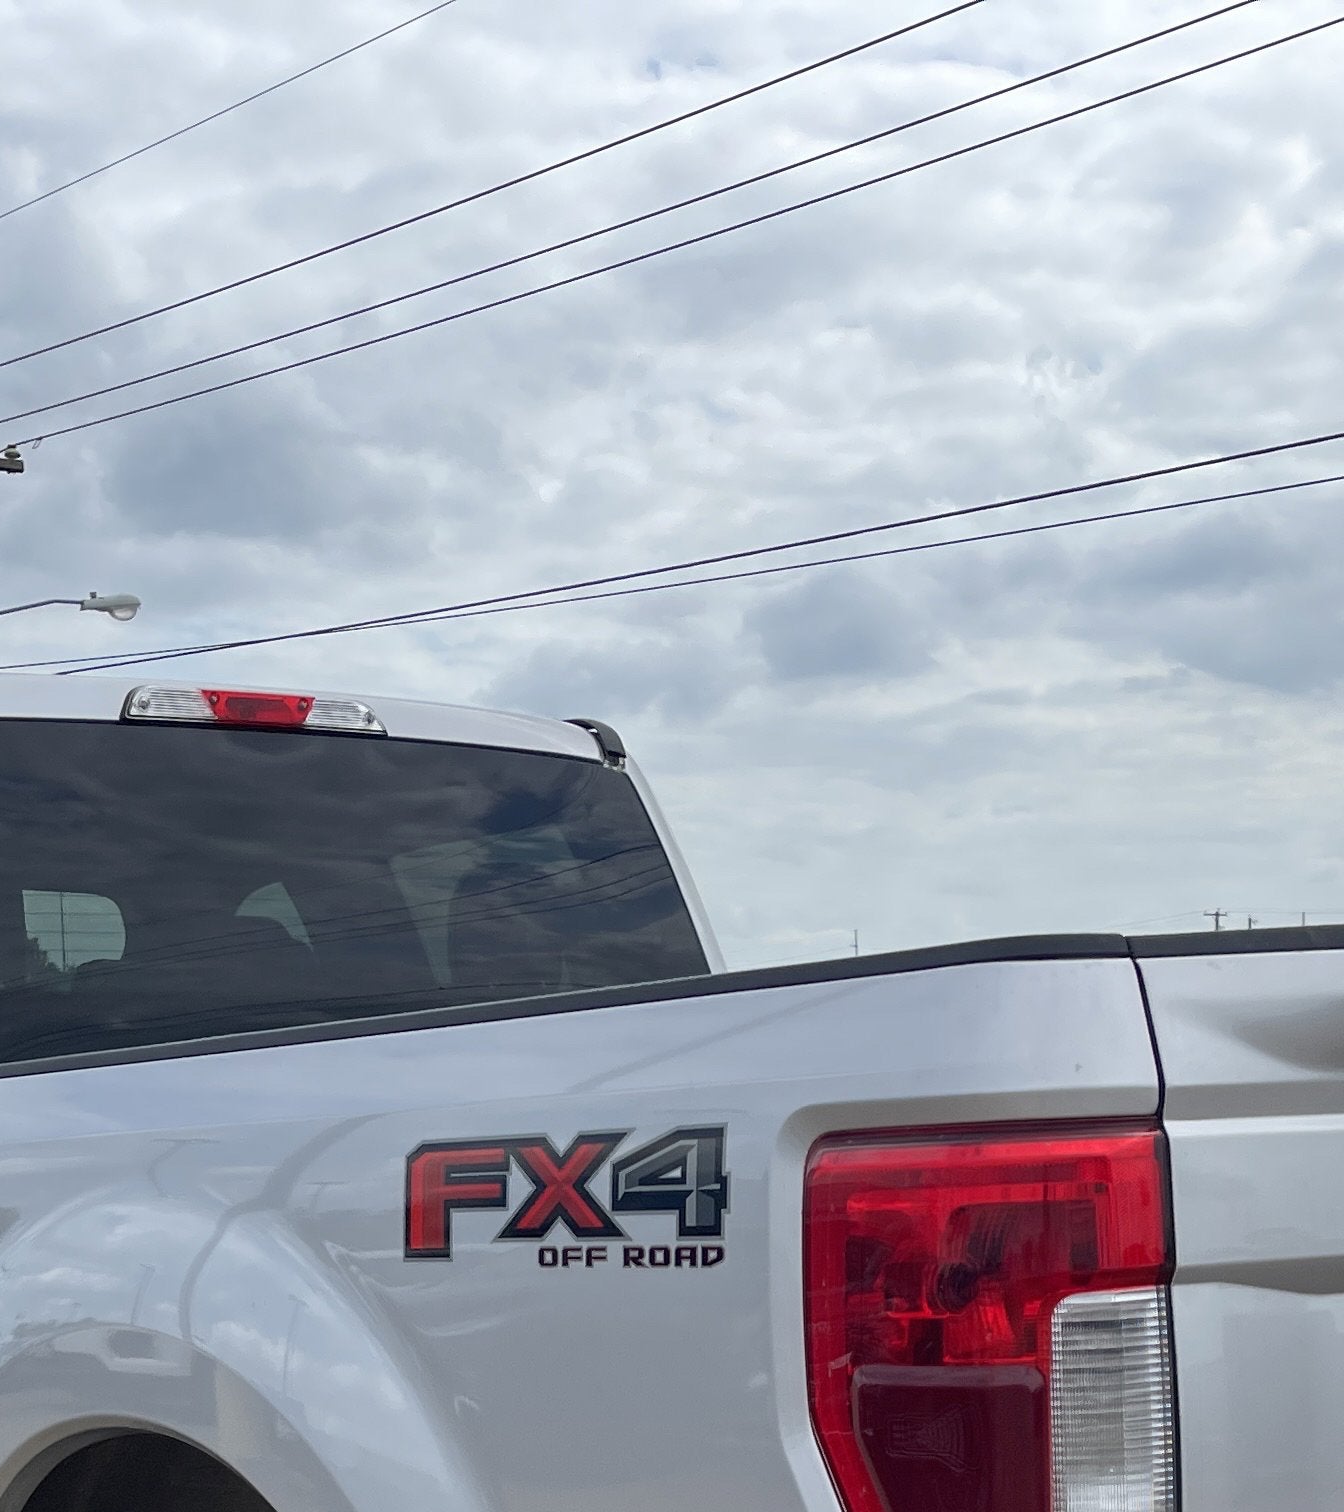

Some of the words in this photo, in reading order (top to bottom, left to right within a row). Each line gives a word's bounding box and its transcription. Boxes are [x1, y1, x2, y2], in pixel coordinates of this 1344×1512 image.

[403, 1122, 731, 1262] FX4
[538, 1246, 608, 1269] OFF
[622, 1244, 727, 1269] ROAD
